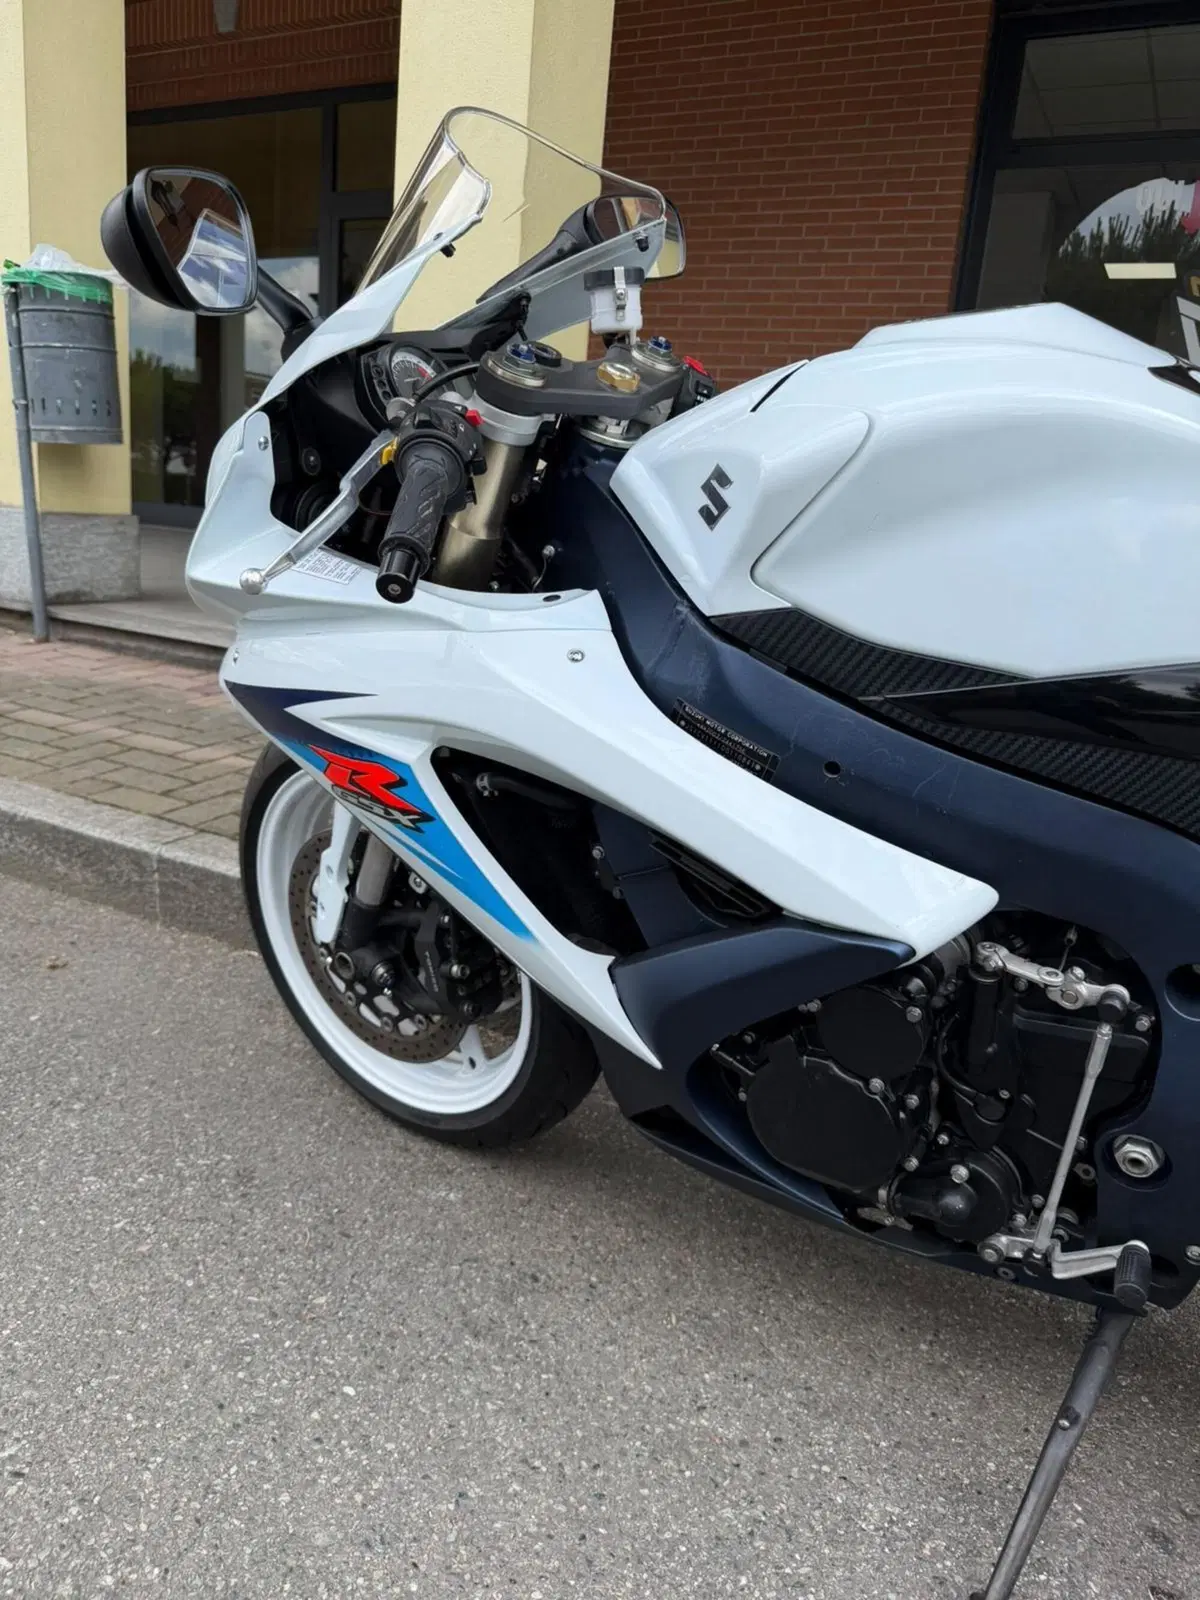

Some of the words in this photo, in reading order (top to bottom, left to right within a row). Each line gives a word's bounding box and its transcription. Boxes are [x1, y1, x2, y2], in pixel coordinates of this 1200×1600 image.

[706, 719, 726, 734] MOTOR
[727, 731, 768, 757] CORPORATION
[309, 744, 422, 815] R
[332, 785, 421, 829] GSX
